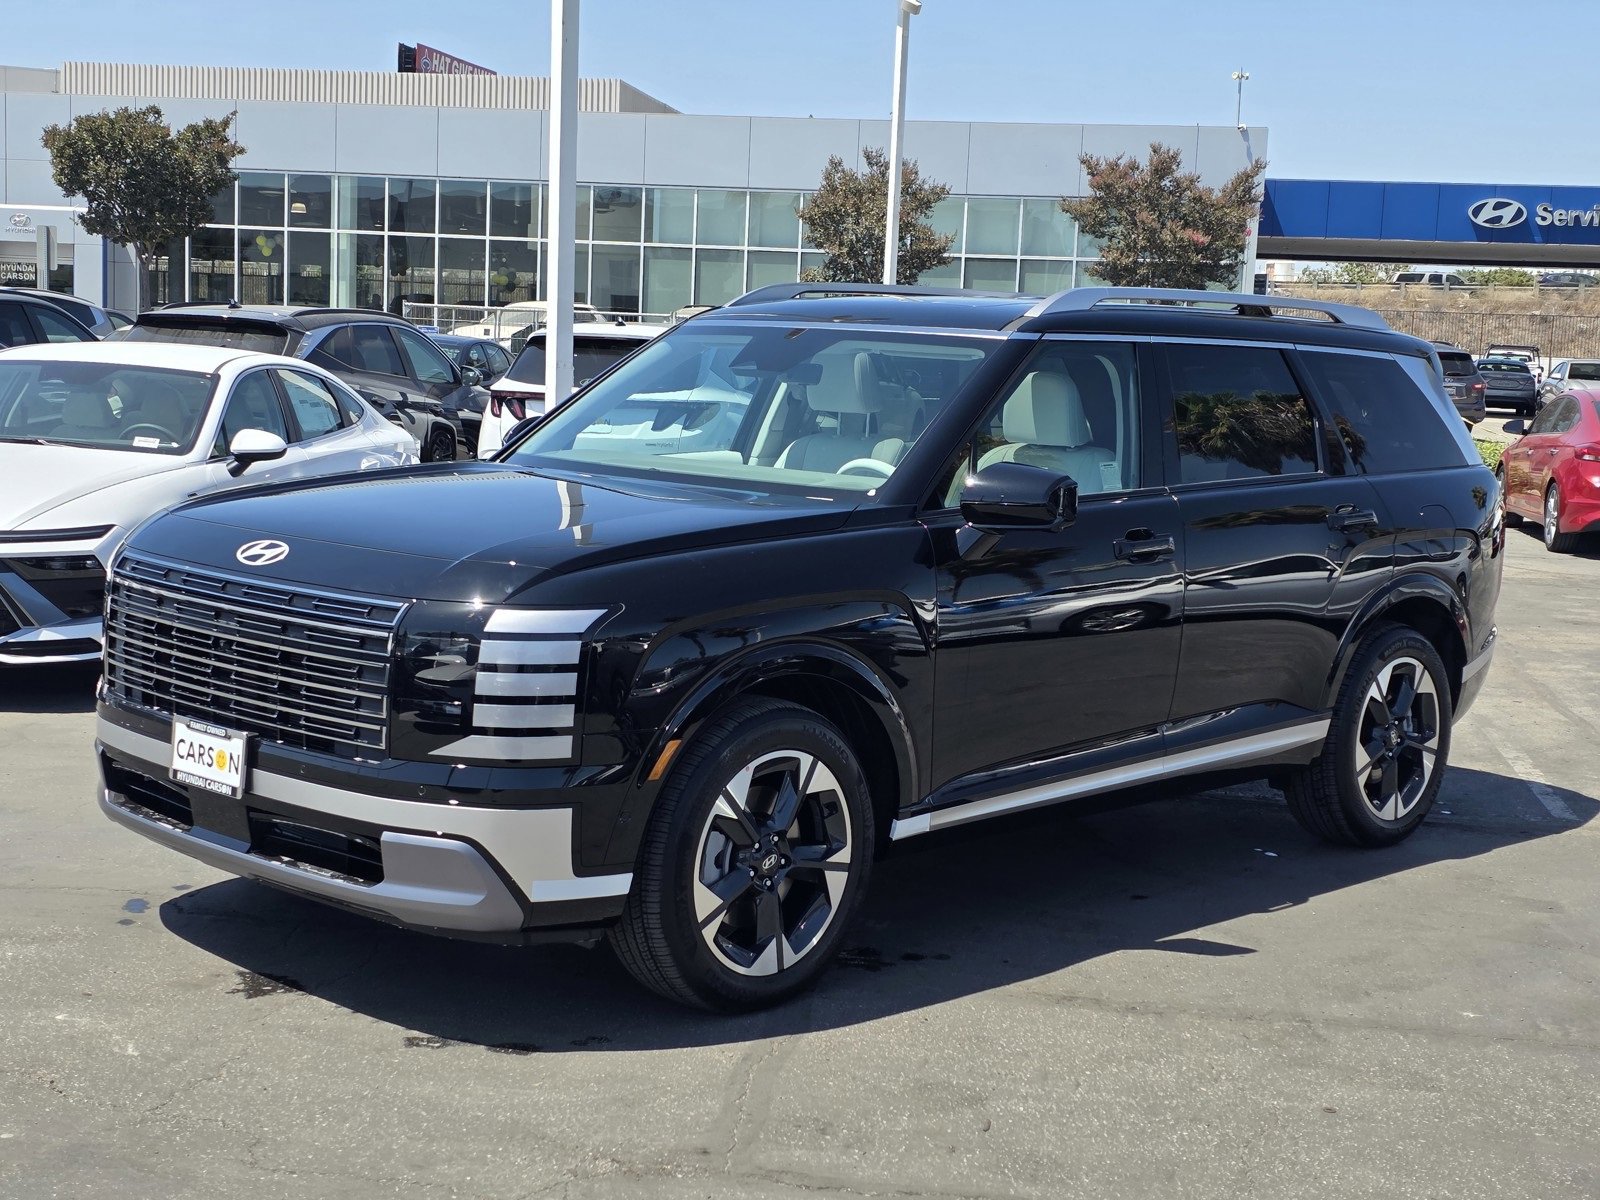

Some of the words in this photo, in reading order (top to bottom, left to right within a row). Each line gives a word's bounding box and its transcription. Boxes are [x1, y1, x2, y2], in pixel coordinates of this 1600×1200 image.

[0, 263, 36, 272] HYUNDAI
[0, 272, 36, 280] CARSON
[176, 771, 206, 788] HYUNDAI
[205, 780, 232, 795] CARSON
